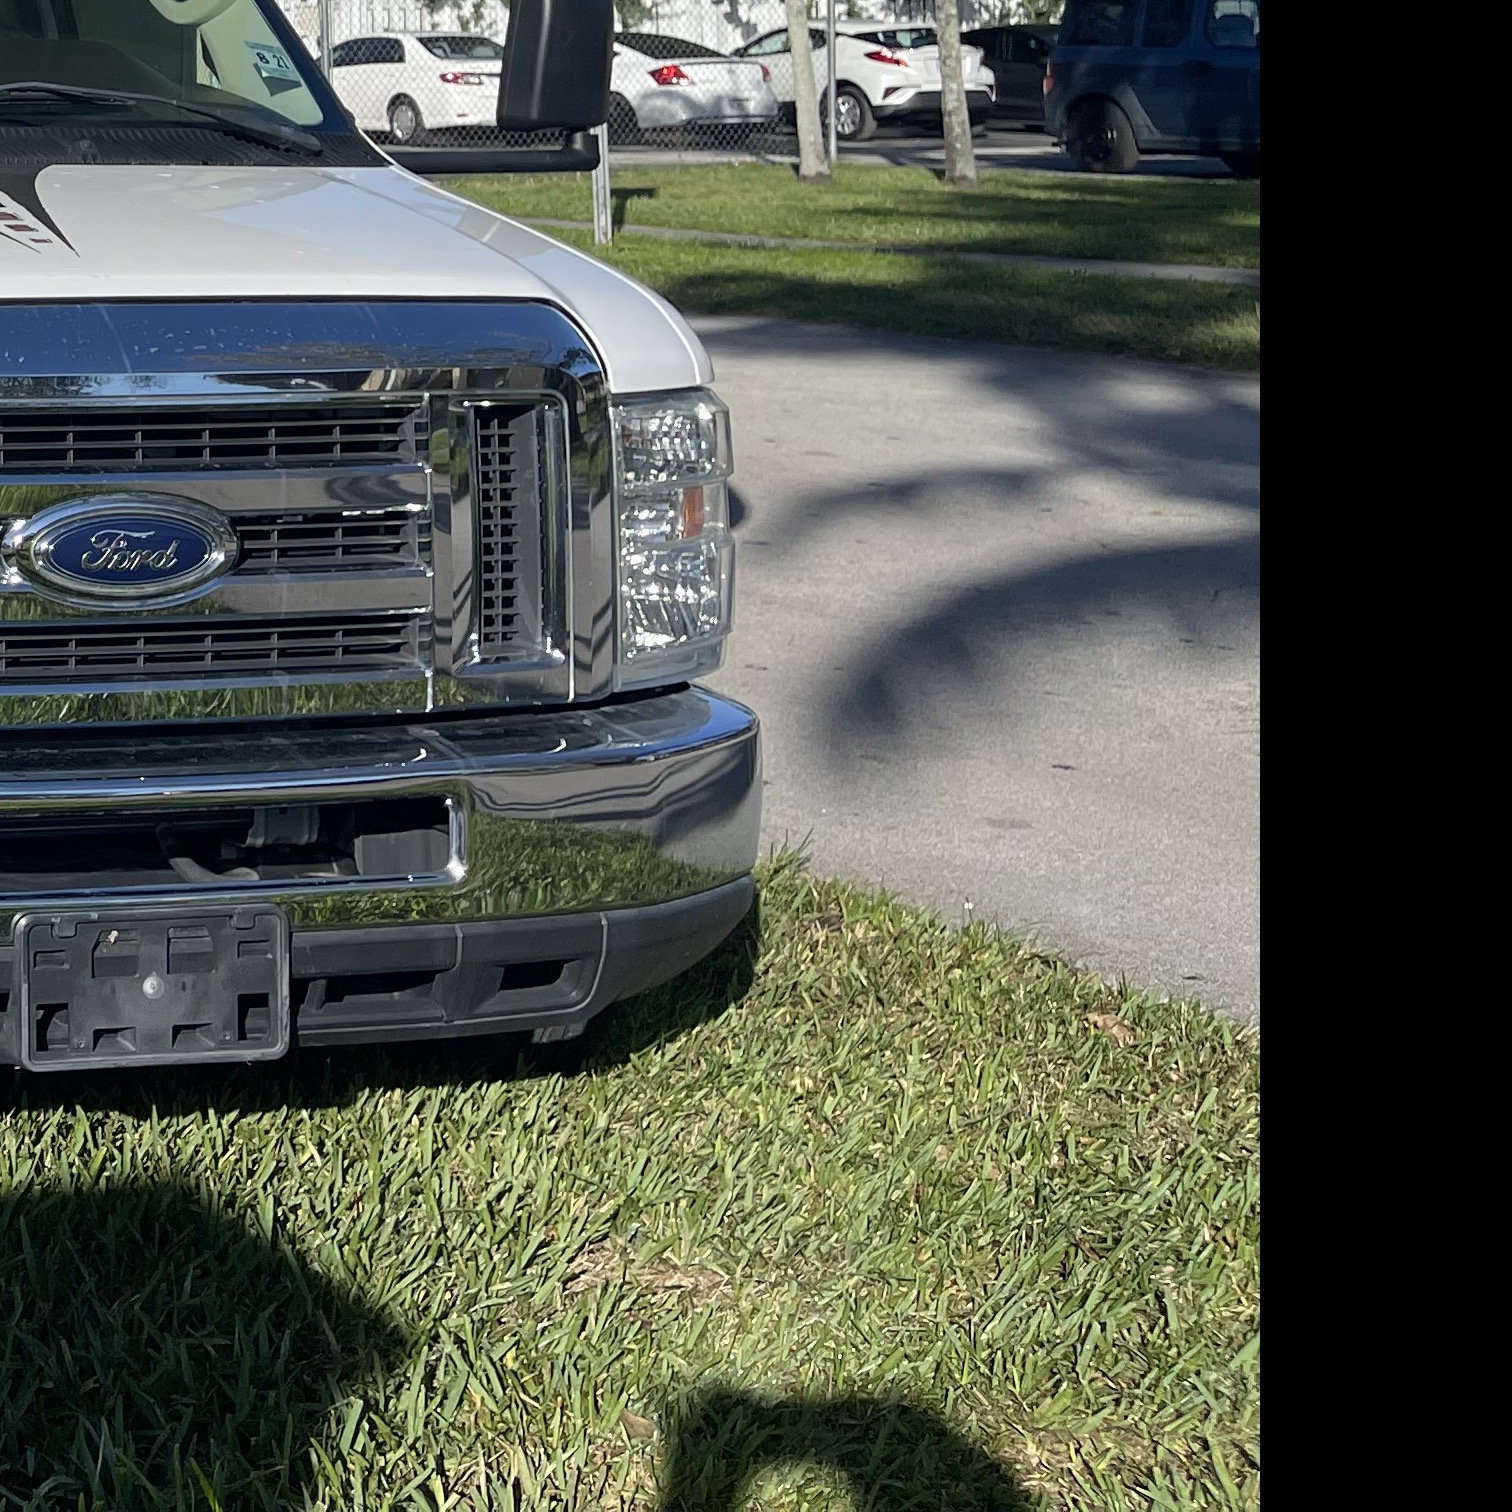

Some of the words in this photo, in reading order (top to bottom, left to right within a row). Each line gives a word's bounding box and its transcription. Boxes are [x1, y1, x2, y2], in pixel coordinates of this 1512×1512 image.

[256, 51, 270, 65] 8
[272, 54, 290, 70] 21
[81, 529, 178, 571] Ford
